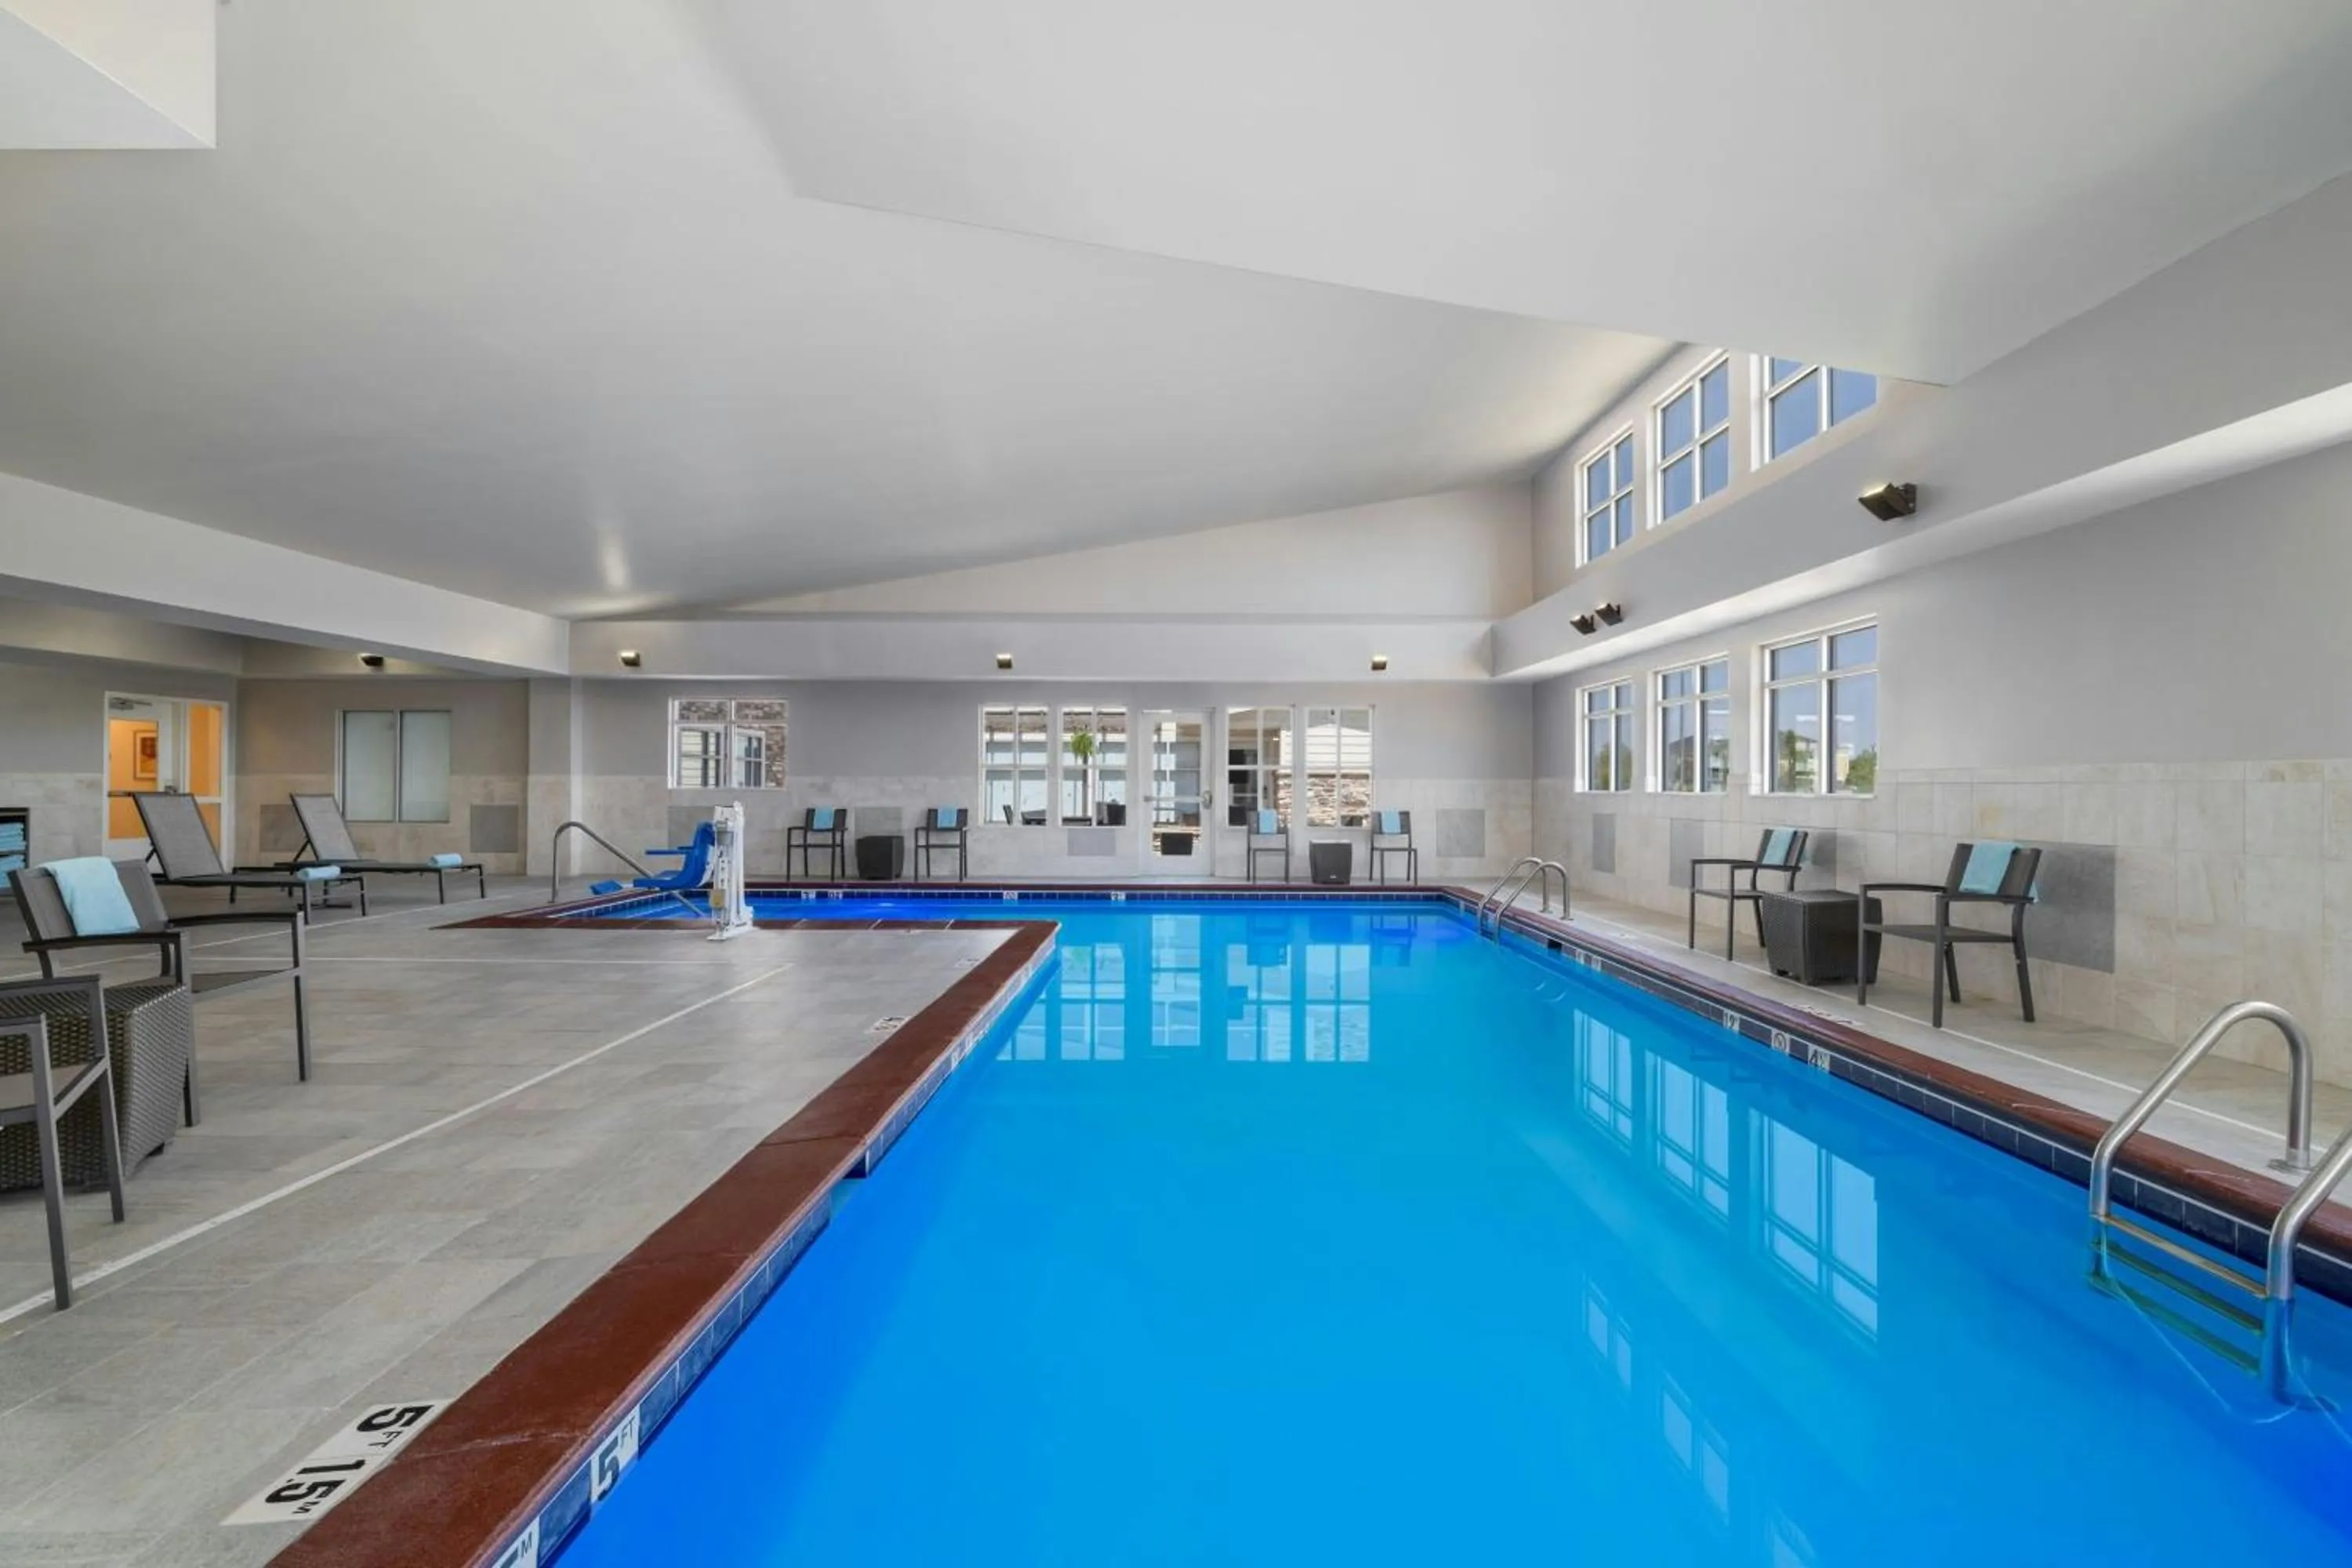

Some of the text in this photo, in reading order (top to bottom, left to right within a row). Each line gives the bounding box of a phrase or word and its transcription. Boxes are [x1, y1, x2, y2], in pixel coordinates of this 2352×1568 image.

[357, 1404, 435, 1448] 5 FT
[597, 1416, 636, 1502] 5 FT
[291, 1501, 321, 1515] M
[521, 1530, 532, 1559] M
